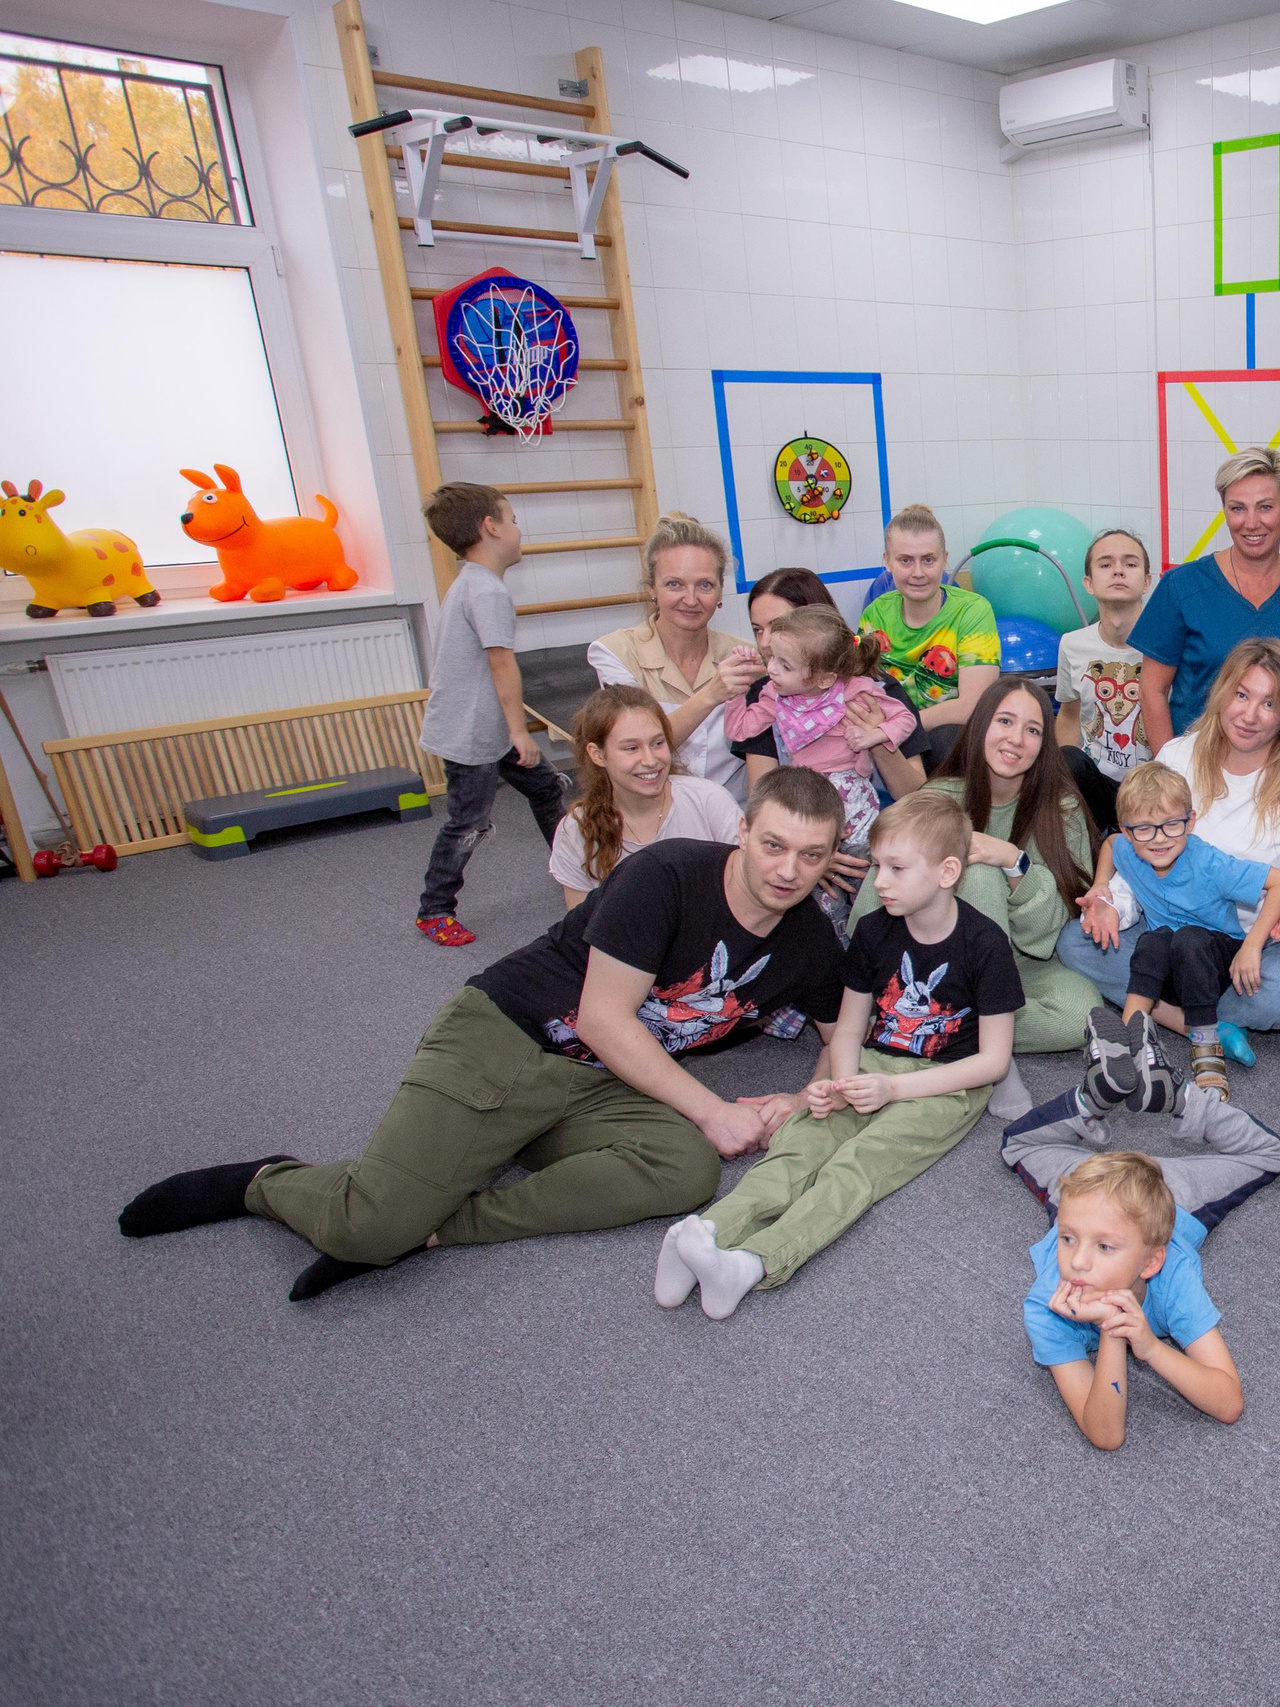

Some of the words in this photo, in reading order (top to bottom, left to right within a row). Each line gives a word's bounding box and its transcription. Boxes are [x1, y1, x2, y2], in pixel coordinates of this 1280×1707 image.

[806, 459, 814, 467] 20
[834, 461, 842, 469] 10
[1105, 730, 1113, 750] I
